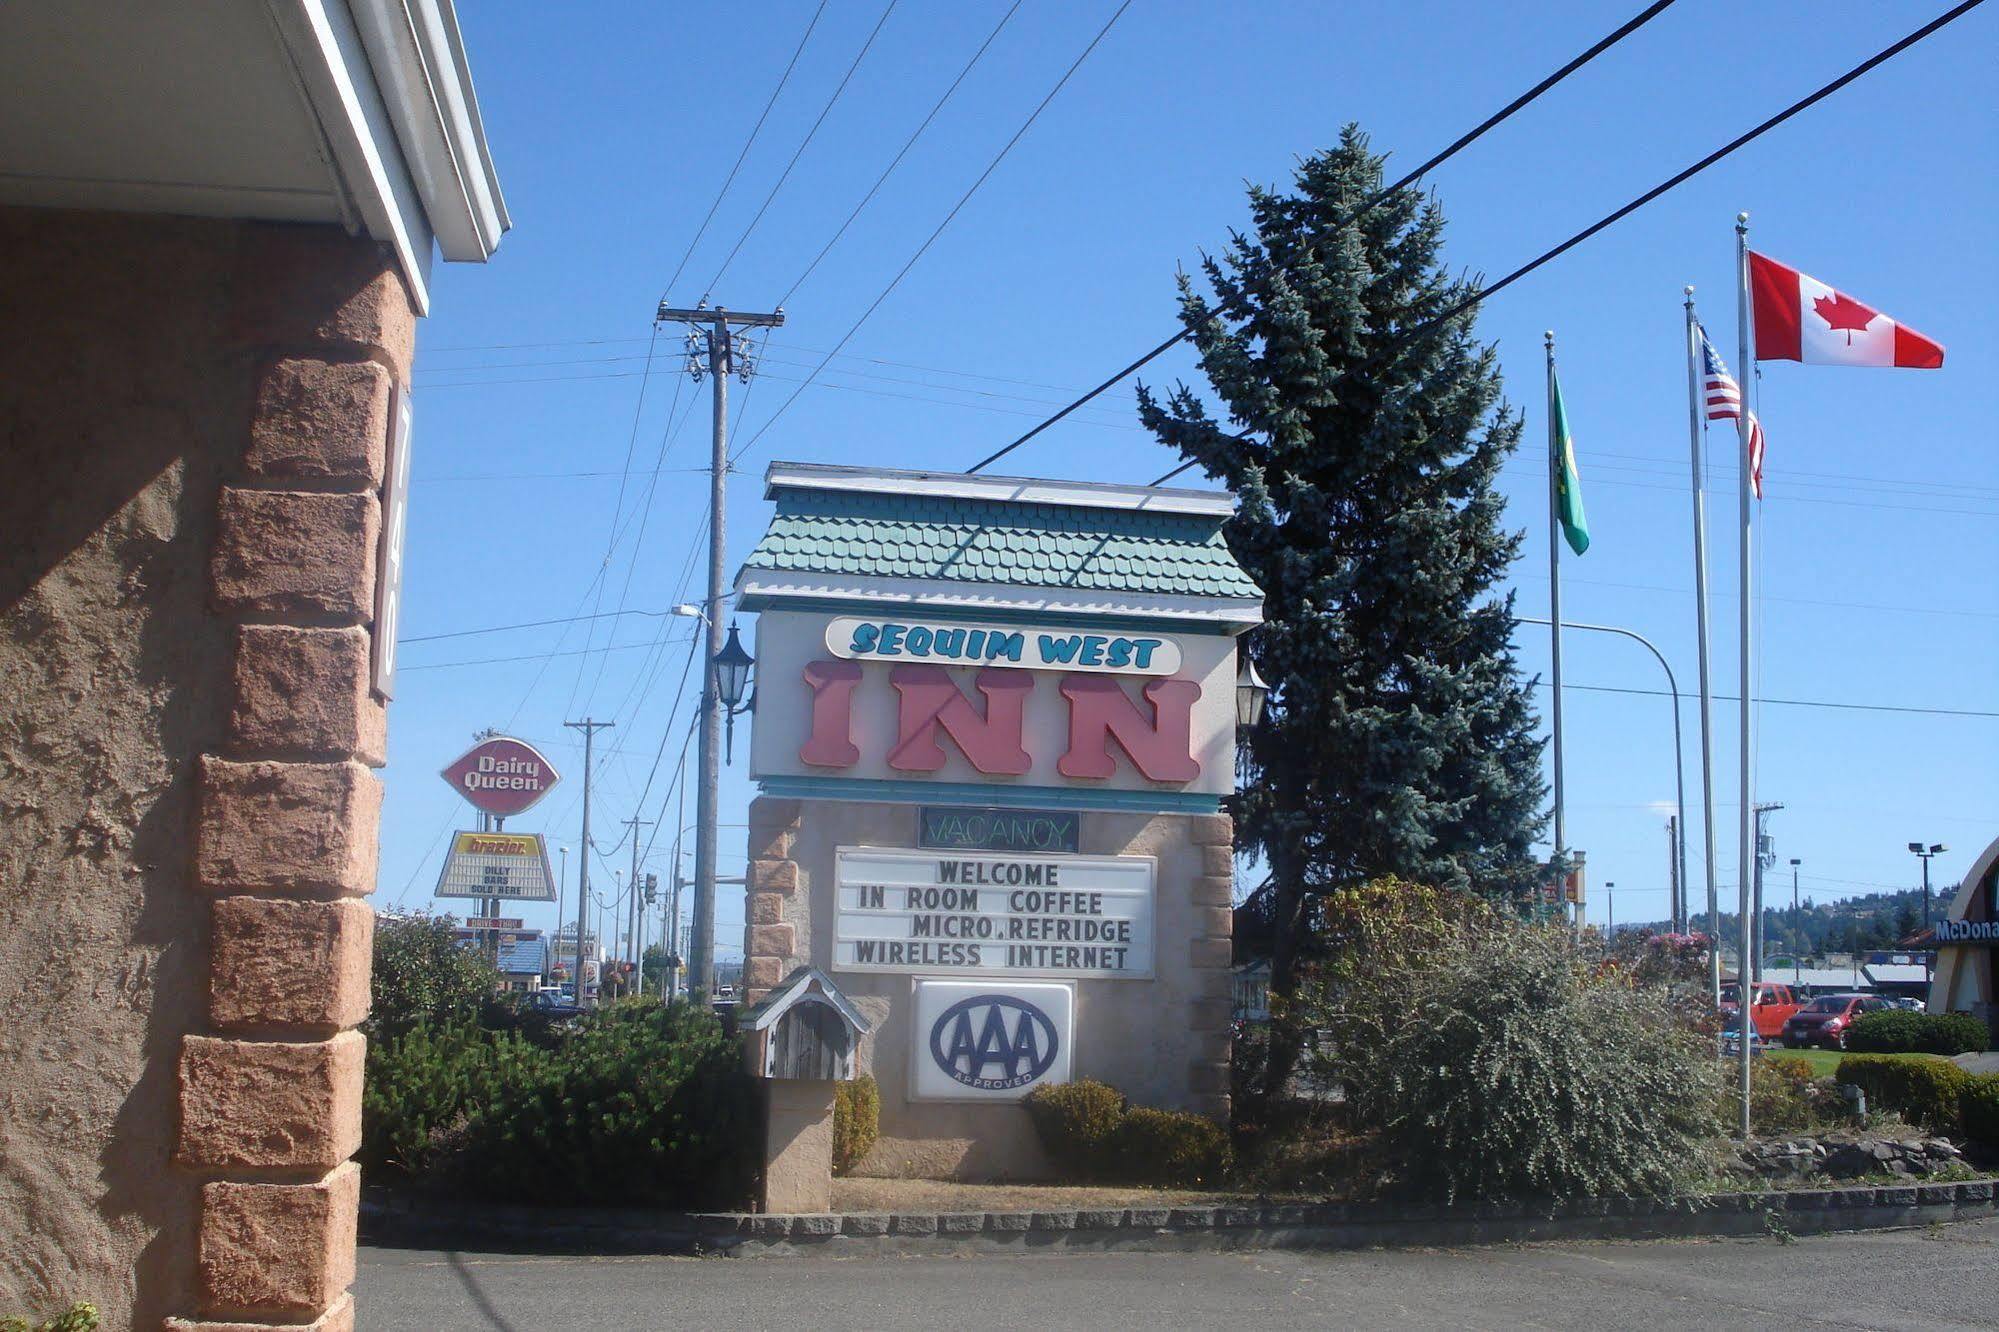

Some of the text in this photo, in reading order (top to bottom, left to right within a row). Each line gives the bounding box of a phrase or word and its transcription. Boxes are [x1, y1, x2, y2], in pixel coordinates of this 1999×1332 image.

[850, 623, 1162, 669] SEQUIM WEST
[800, 660, 1202, 783] INN
[478, 756, 540, 777] Dairy
[927, 815, 1071, 848] VACANCY
[484, 866, 511, 876] DILLY
[484, 876, 509, 885] BARS
[939, 860, 1059, 887] WELCOME
[471, 885, 522, 895] SOLD HERE
[860, 885, 1102, 914] IN ROOM COFFEE
[856, 940, 1128, 969] WIRELESS INTERNET
[946, 1003, 1041, 1078] AAA
[954, 1072, 1033, 1090] APPROVED
